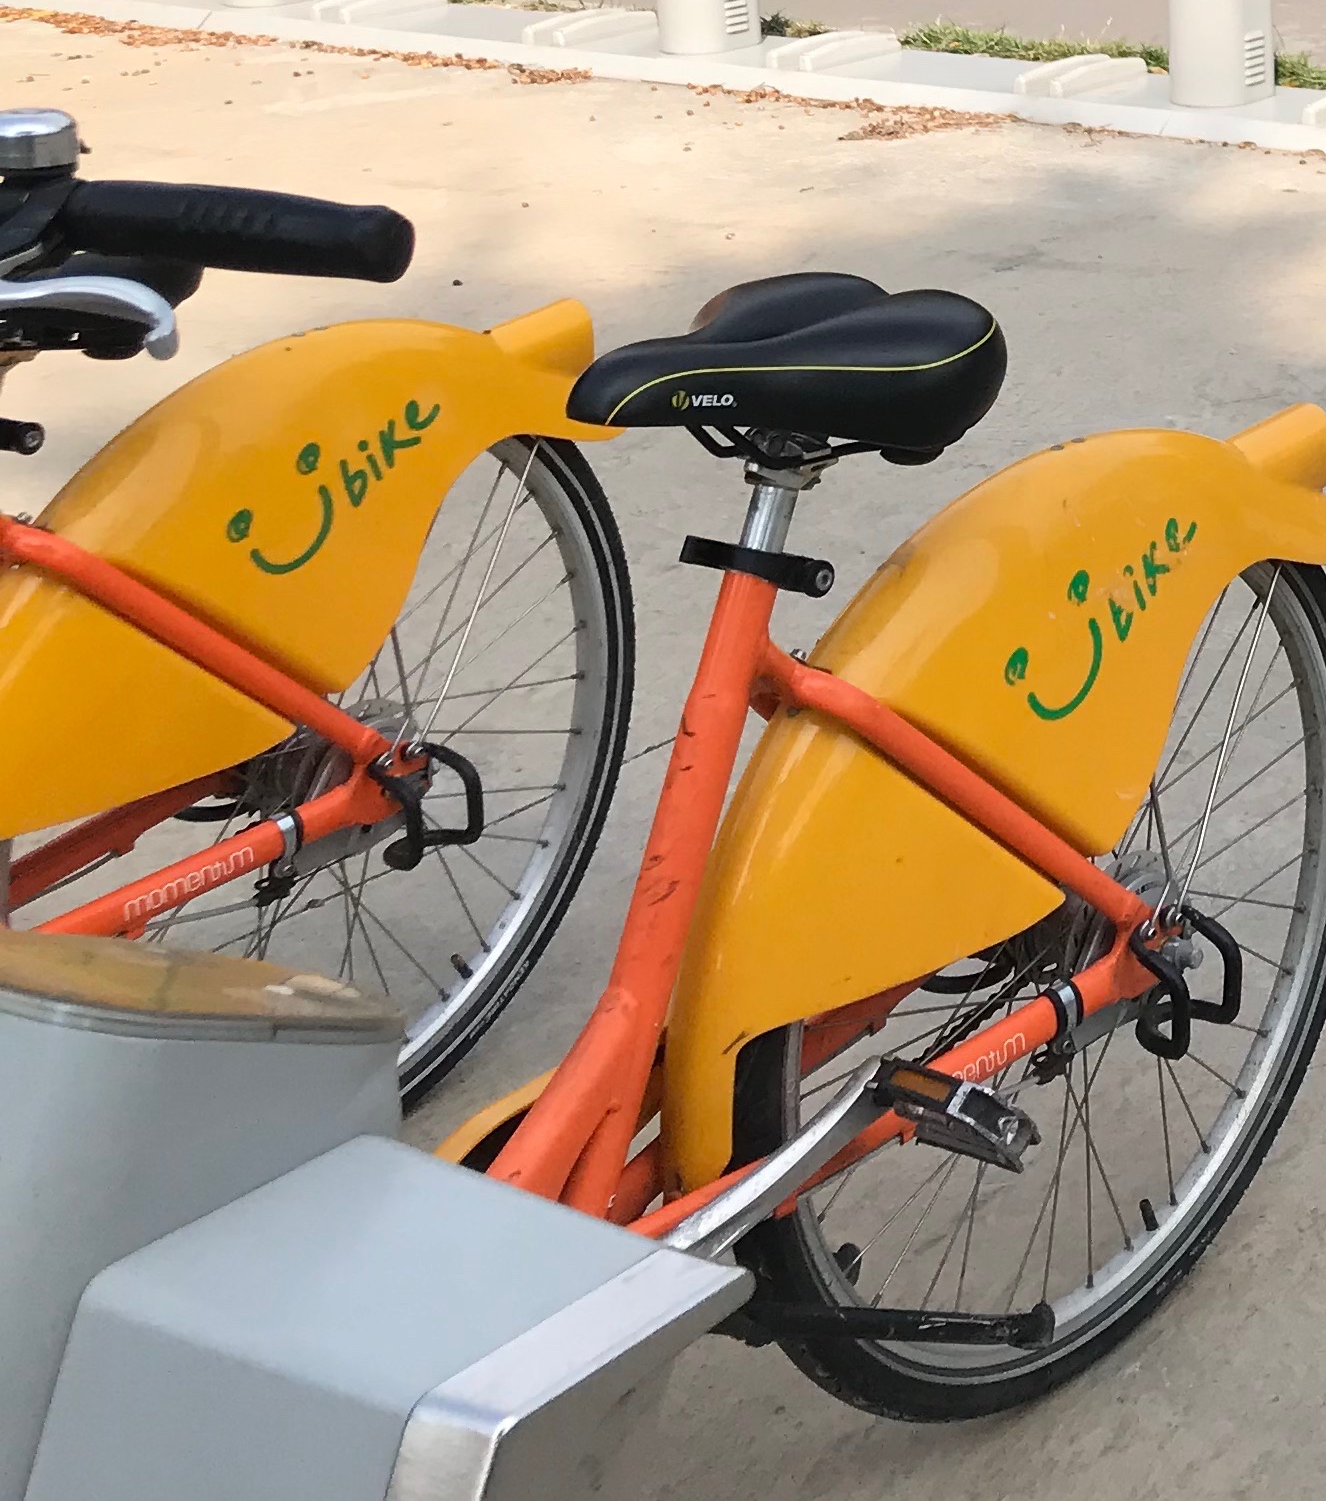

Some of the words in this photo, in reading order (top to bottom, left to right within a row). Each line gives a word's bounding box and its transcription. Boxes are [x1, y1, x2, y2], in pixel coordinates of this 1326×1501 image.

[691, 394, 735, 407] VELO
[124, 846, 254, 921] momentum
[951, 1032, 1026, 1081] entum
